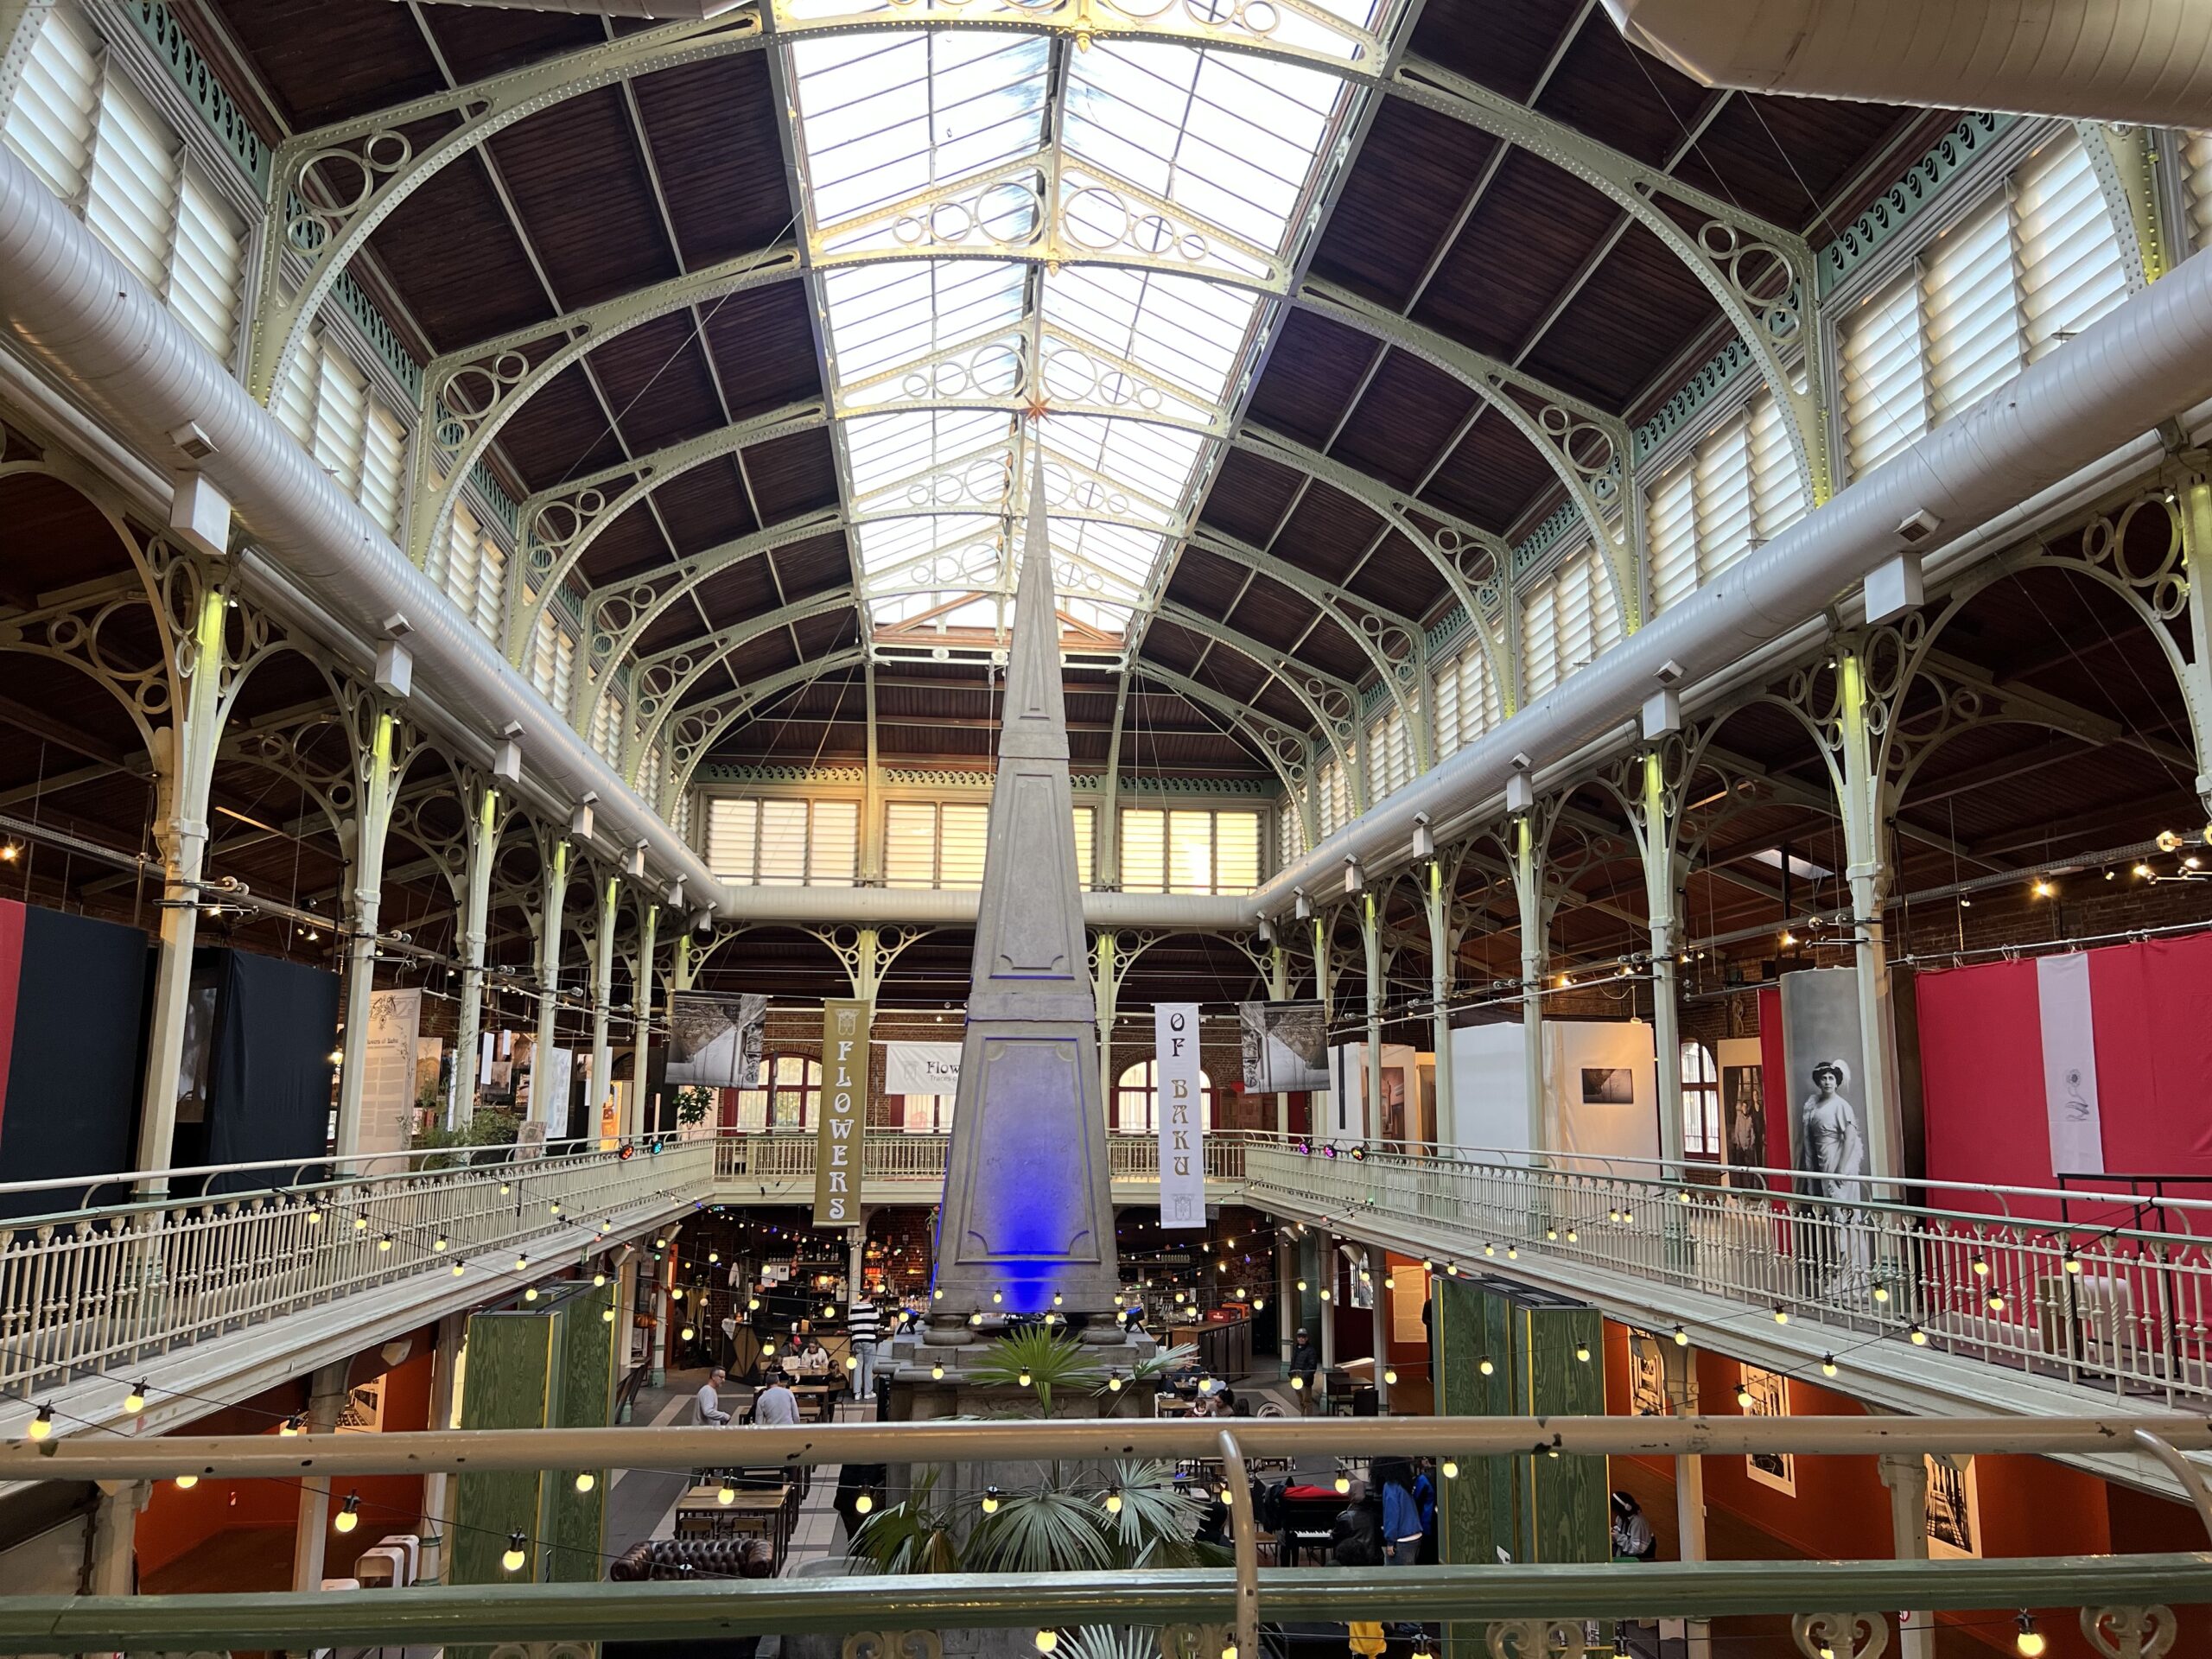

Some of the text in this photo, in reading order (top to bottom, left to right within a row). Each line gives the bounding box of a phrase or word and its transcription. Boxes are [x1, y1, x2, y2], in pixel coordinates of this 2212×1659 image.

[829, 1040, 855, 1219] FLOWERS
[1170, 1013, 1191, 1176] OF BAKU
